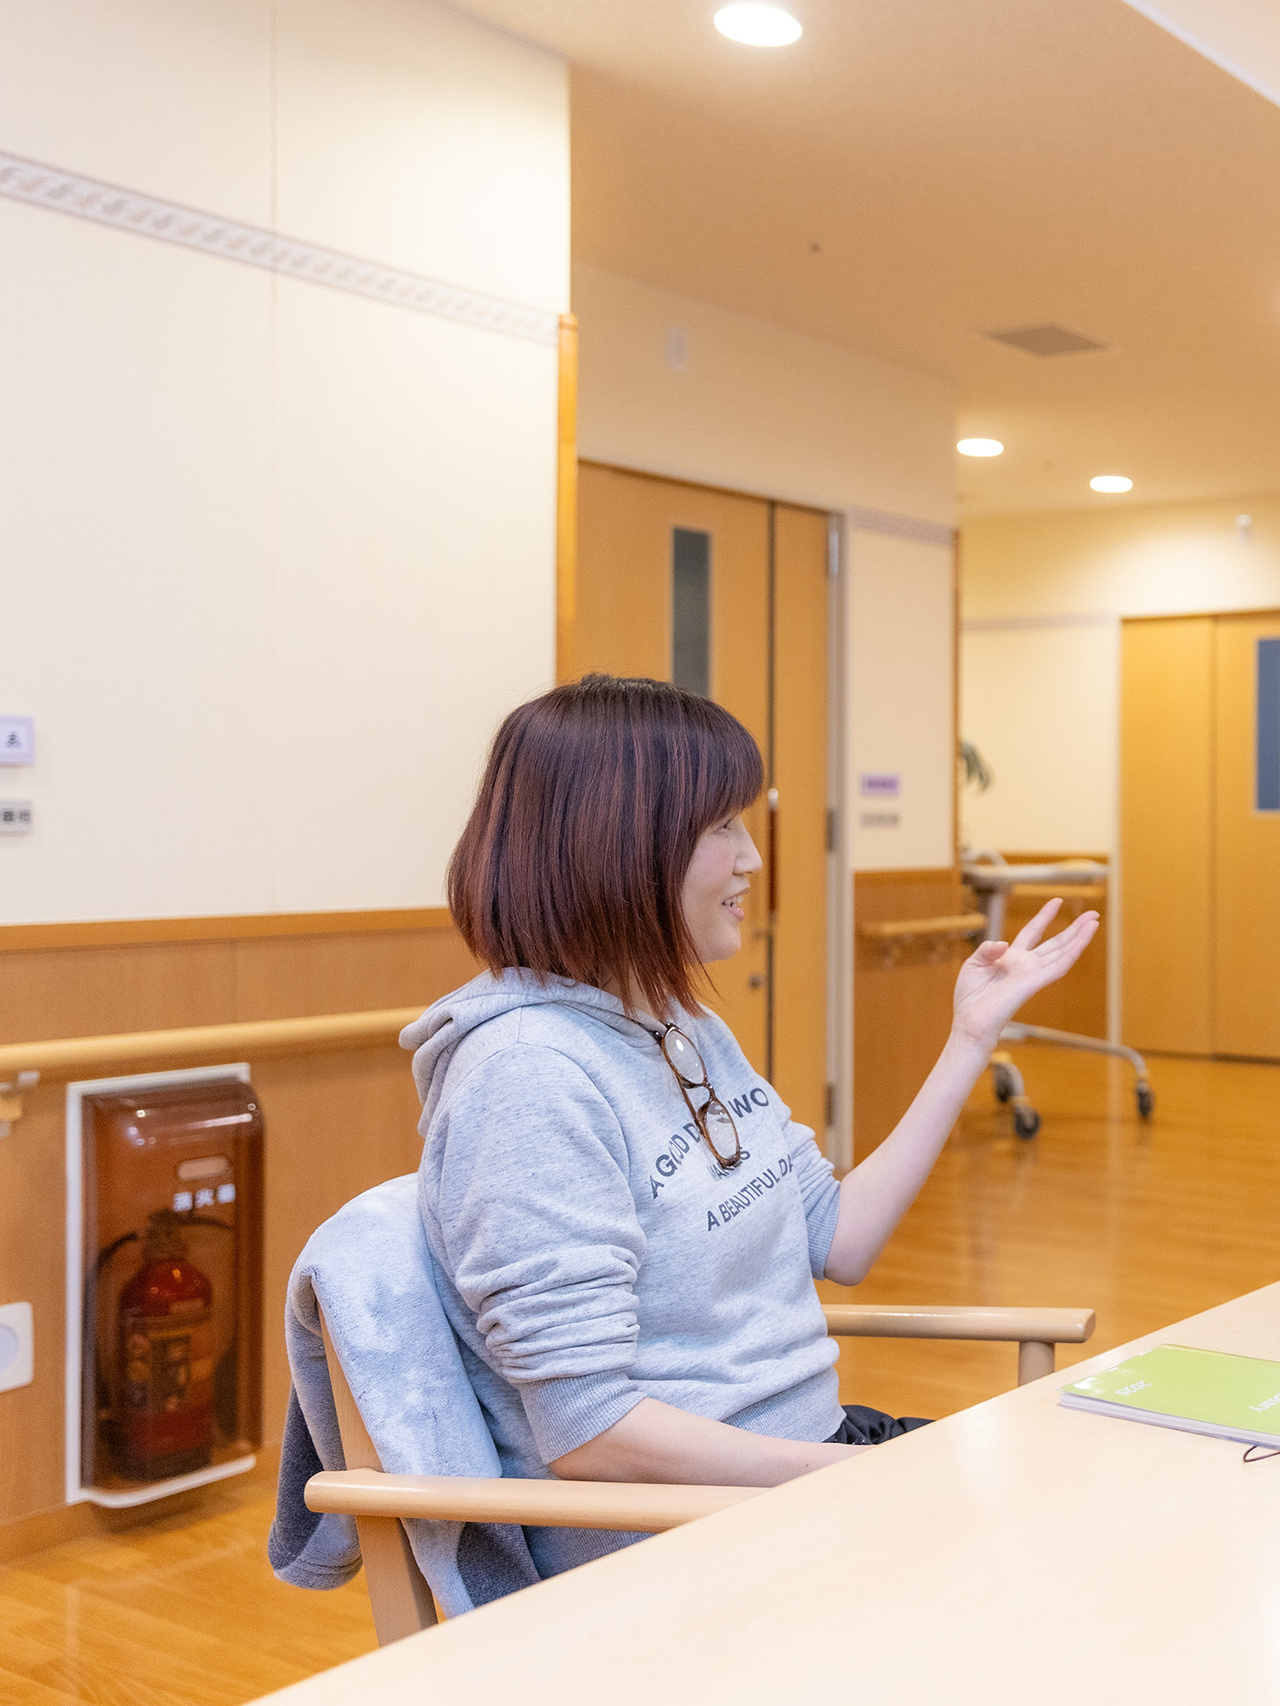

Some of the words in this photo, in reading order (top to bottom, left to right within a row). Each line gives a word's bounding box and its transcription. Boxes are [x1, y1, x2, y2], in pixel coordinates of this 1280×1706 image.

[650, 1174, 665, 1199] A
[706, 1210, 721, 1231] A
[718, 1168, 780, 1223] BEAUTIFUL
[1114, 1379, 1152, 1397] 2025
